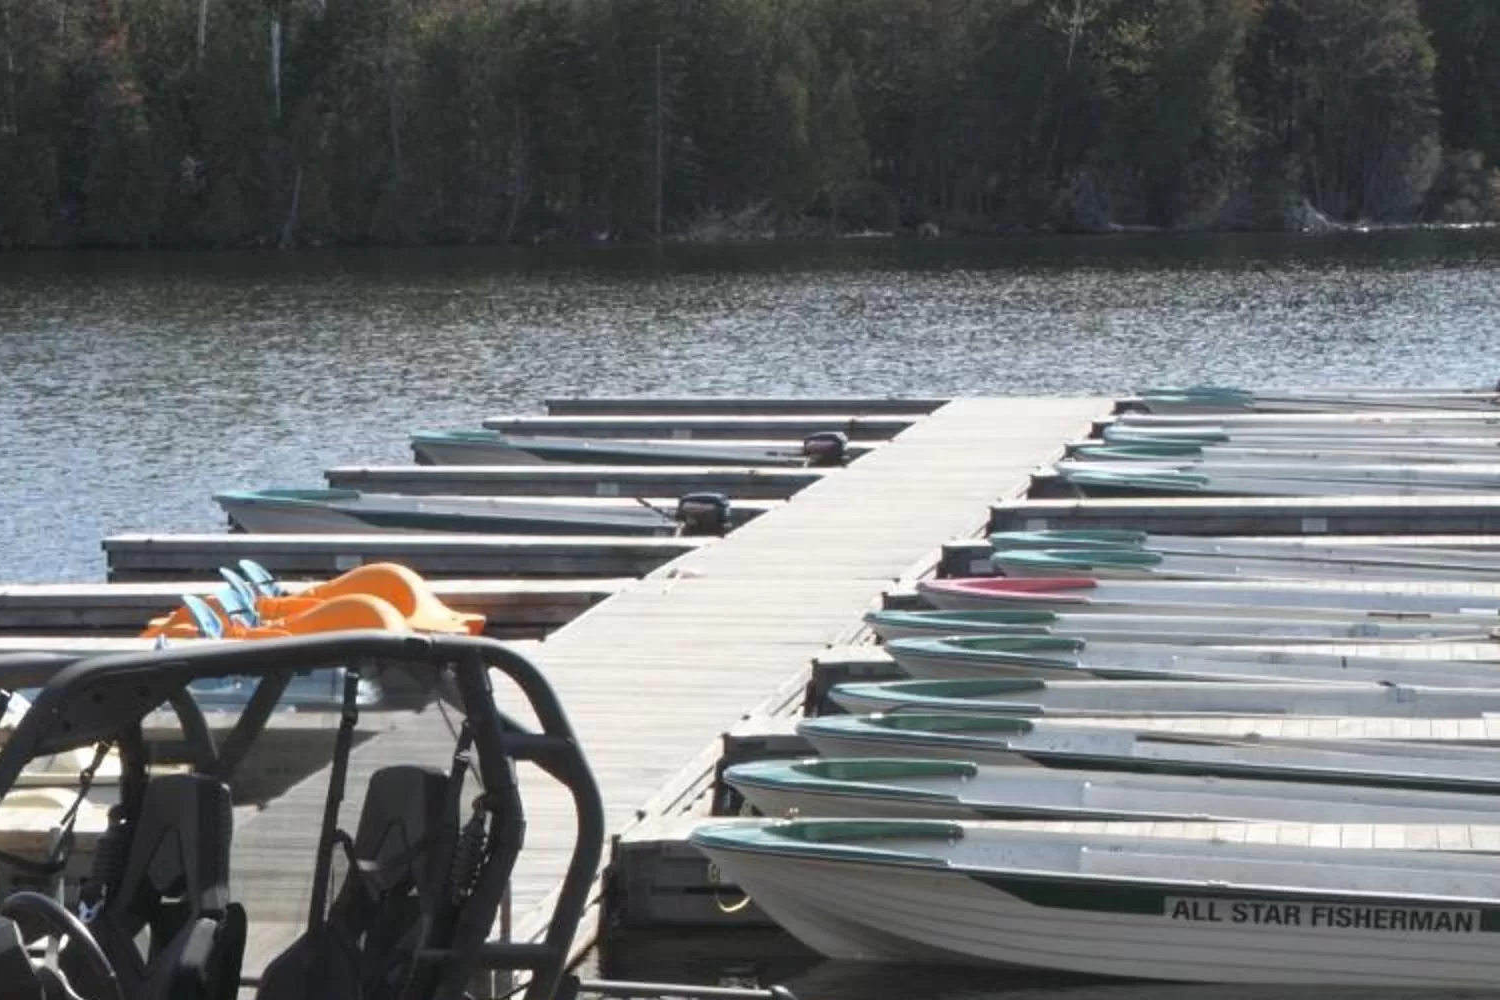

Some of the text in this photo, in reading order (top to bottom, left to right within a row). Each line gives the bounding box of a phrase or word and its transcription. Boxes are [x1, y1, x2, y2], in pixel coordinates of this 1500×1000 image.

[1171, 900, 1473, 932] ALL STAR FISHERMAN
